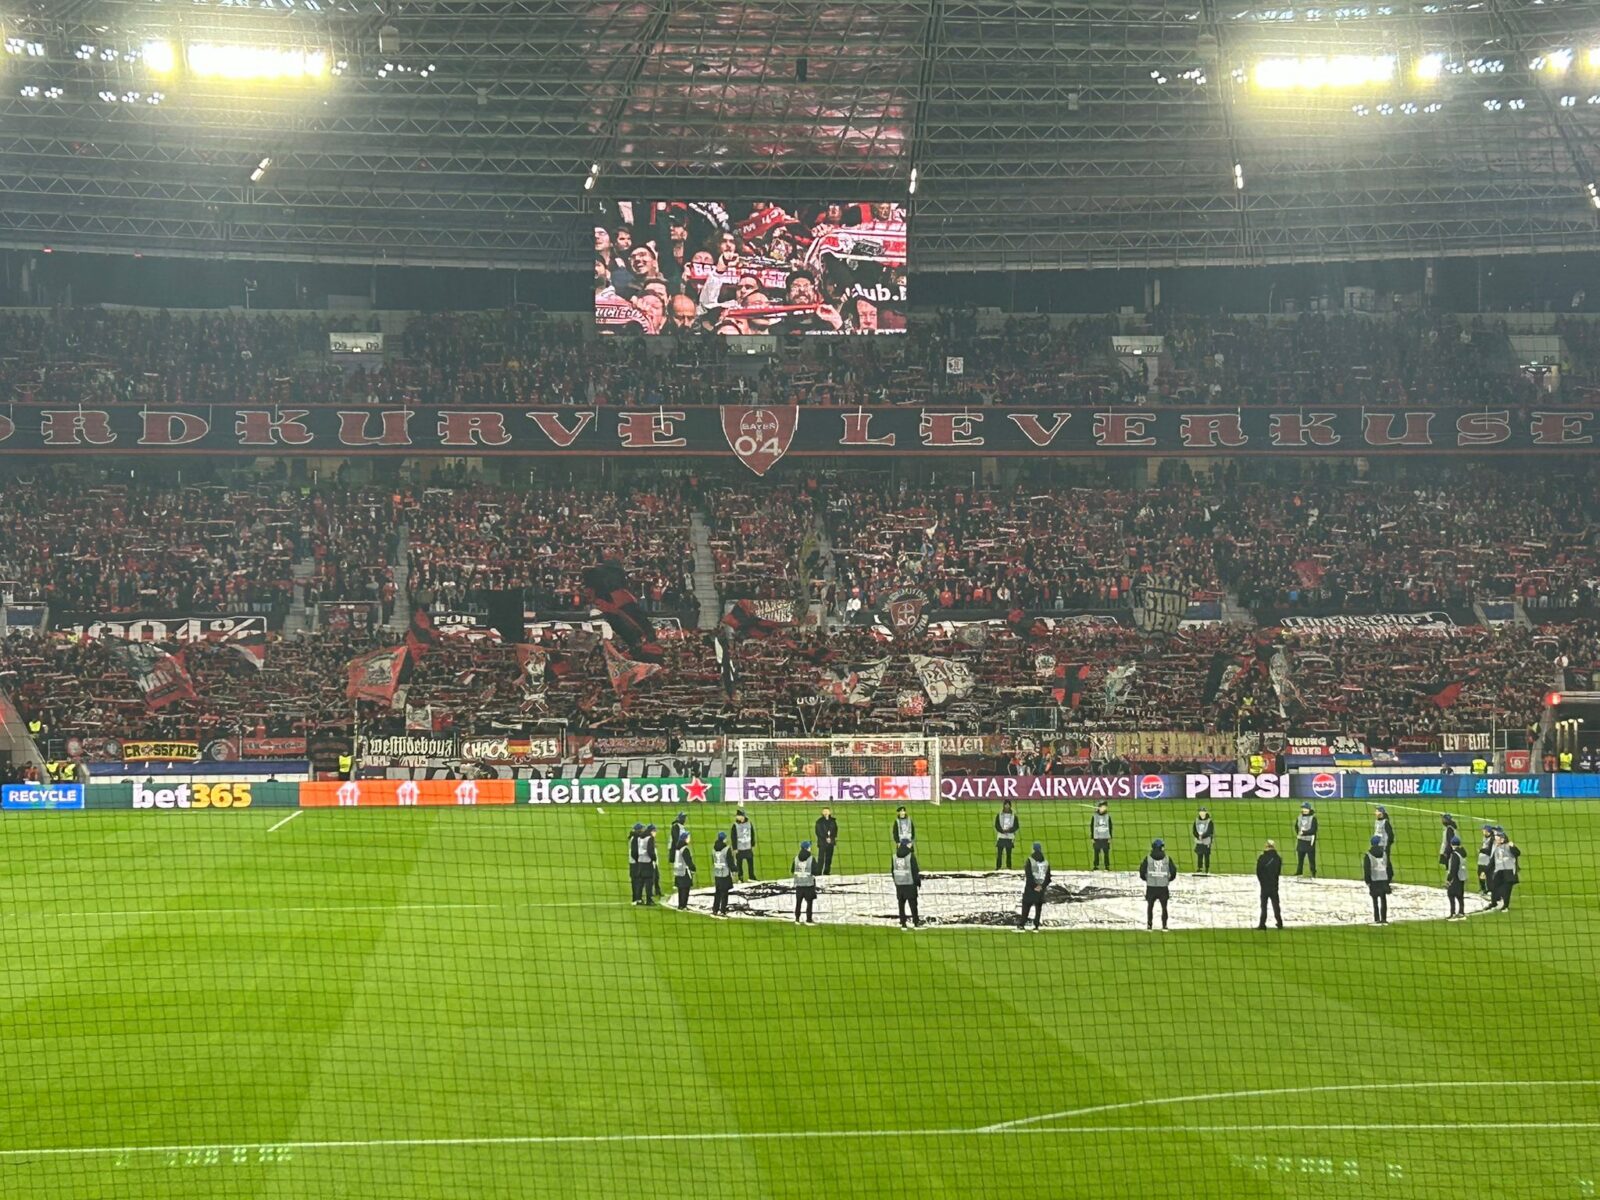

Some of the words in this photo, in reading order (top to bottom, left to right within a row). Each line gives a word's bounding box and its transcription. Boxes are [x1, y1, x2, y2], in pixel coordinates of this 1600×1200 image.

[735, 435, 782, 456] 04
[9, 790, 77, 802] RECYCLE
[132, 783, 252, 808] bet365
[528, 778, 680, 804] Heineken
[743, 777, 816, 800] FedEx
[838, 776, 909, 800] FedEx
[941, 777, 1019, 801] QATAR
[1028, 777, 1131, 797] AIRWAYS
[1185, 773, 1290, 798] PEPSI
